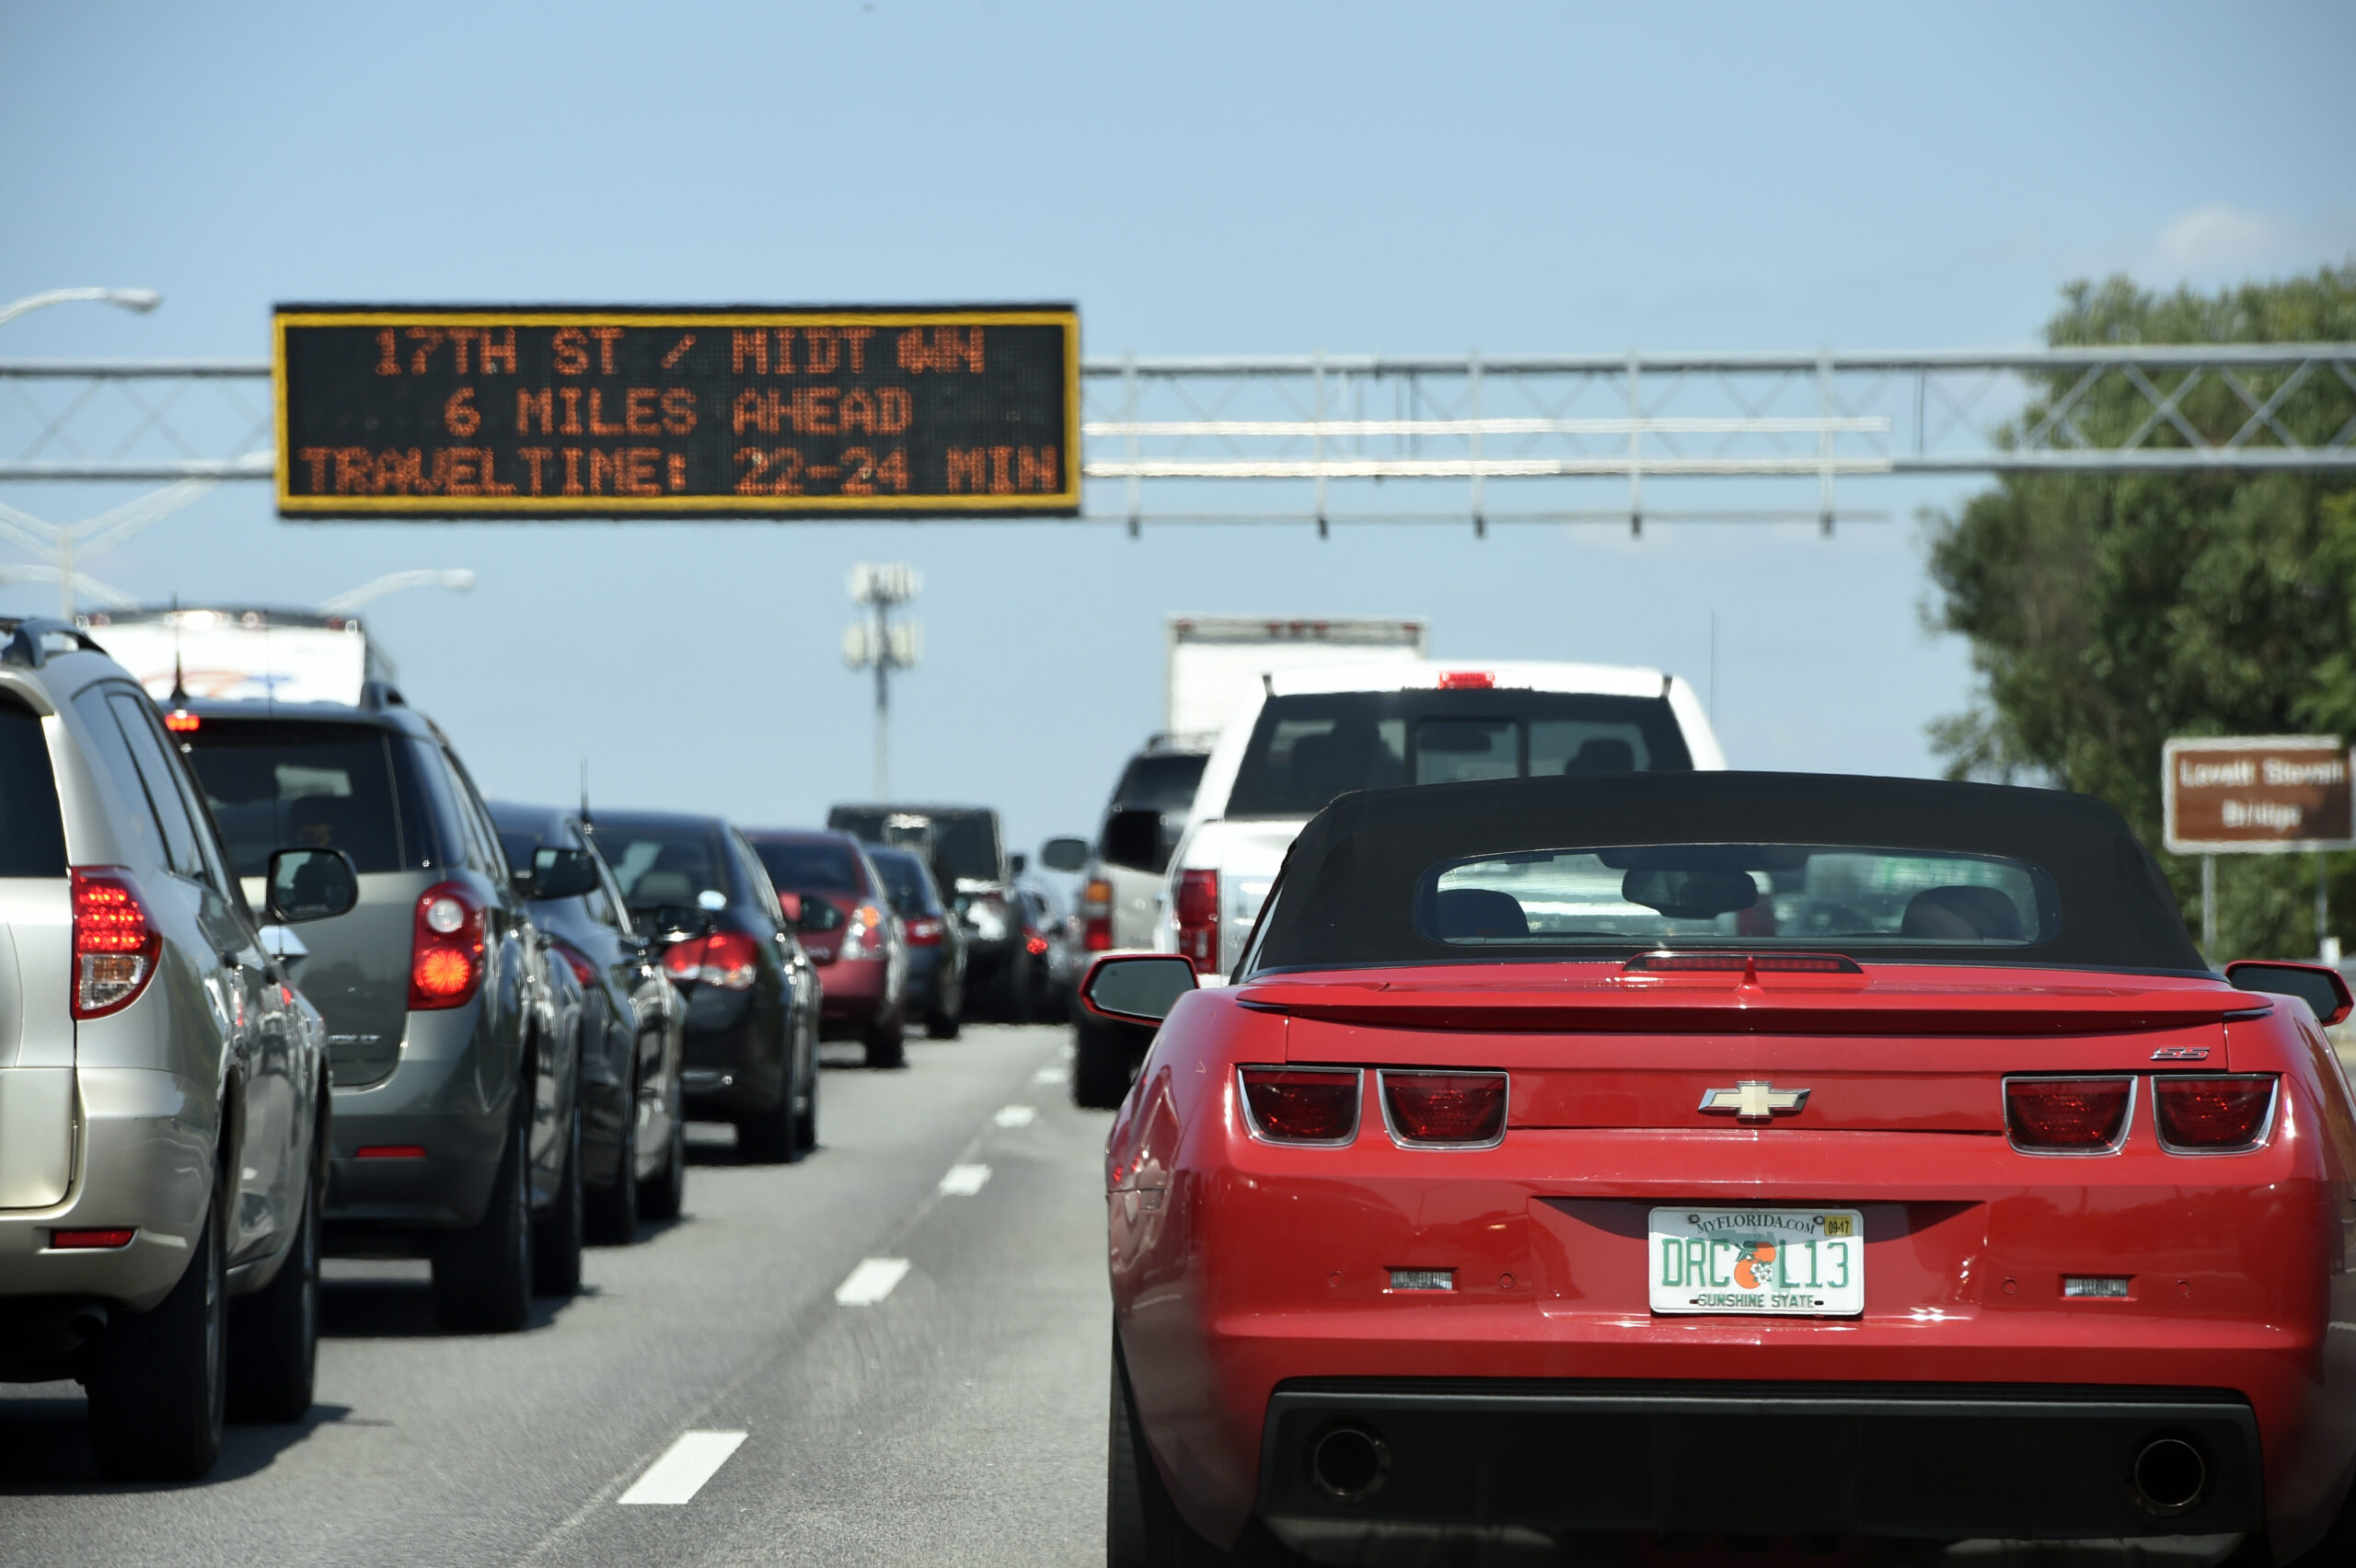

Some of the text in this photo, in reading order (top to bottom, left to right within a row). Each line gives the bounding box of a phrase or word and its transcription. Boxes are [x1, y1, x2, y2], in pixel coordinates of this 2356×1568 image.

[375, 327, 516, 375] 17TH
[553, 326, 625, 375] ST
[661, 331, 697, 369] /
[444, 386, 913, 437] 6 MILES AHEAD
[733, 446, 910, 496] 22-24
[946, 444, 1057, 495] MIN
[2223, 798, 2303, 834] Bridge
[2150, 1046, 2211, 1061] SS
[1697, 1214, 1816, 1235] MYFLORIDA.COM
[1828, 1220, 1850, 1235] 09-17
[1662, 1238, 1849, 1288] DRC L13
[1698, 1294, 1815, 1309] SUNSHINE STATE
